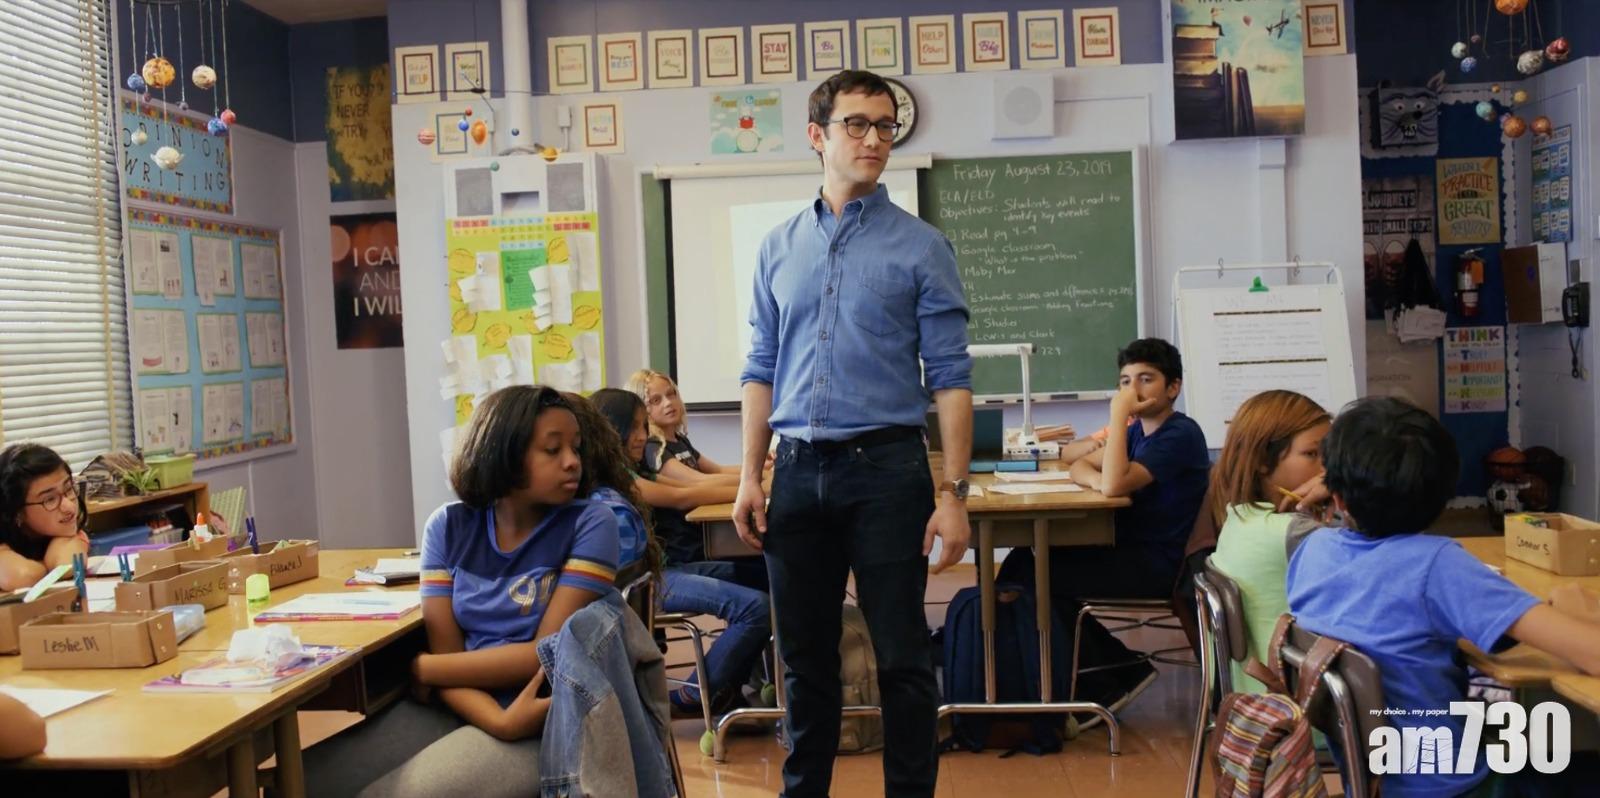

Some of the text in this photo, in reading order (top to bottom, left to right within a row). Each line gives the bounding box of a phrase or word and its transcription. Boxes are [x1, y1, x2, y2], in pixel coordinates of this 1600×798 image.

[922, 31, 944, 41] HELP
[764, 42, 787, 54] STAY
[336, 103, 370, 119] NEVER
[124, 150, 226, 193] WRITING
[952, 163, 997, 189] Friday
[1004, 162, 1051, 185] August
[1081, 159, 1113, 176] 2019
[1441, 172, 1494, 195] PRACTICE
[1369, 190, 1417, 208] JOURNEYS
[1443, 199, 1494, 222] GREAT
[961, 228, 989, 241] Read
[353, 247, 359, 267] I
[964, 265, 993, 280] Moby
[353, 296, 360, 317] I
[1446, 327, 1501, 343] THINK
[1542, 543, 1551, 556] S
[82, 635, 100, 653] M
